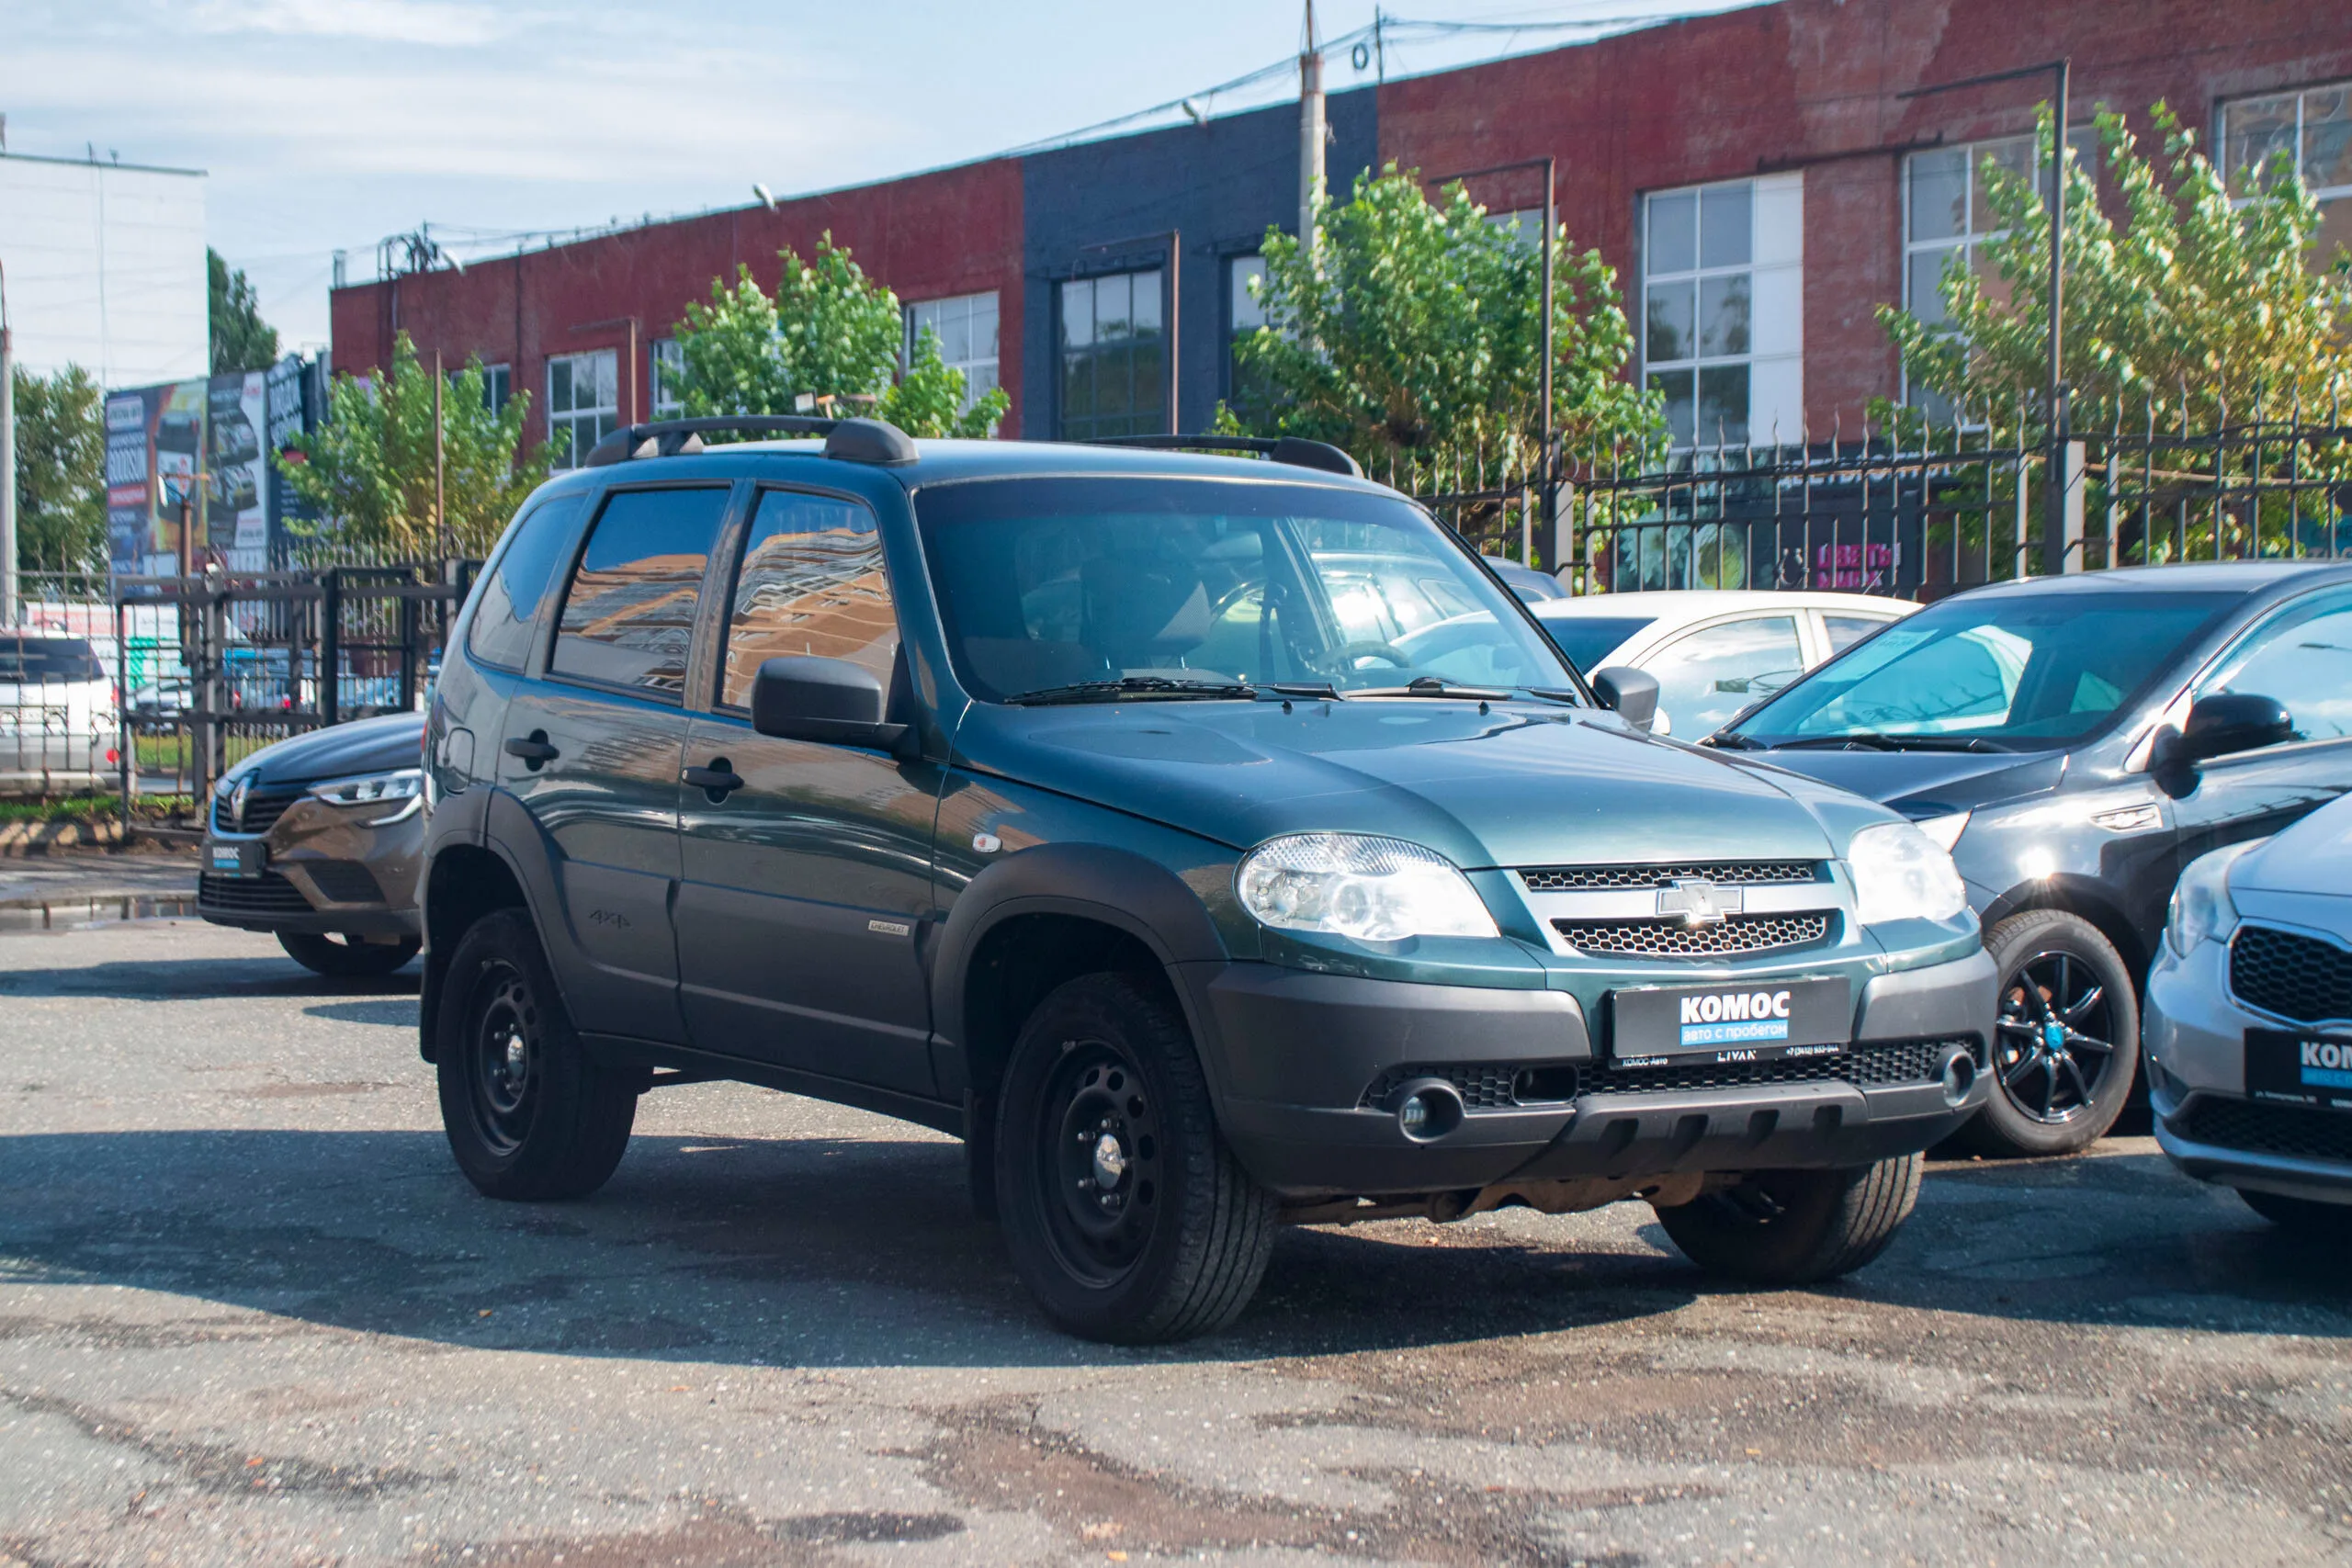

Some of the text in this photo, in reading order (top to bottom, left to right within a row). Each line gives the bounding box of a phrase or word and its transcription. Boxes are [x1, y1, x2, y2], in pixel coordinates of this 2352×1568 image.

[1680, 991, 1791, 1023] КОМОС
[1683, 1023, 1787, 1043] авто с пробегом
